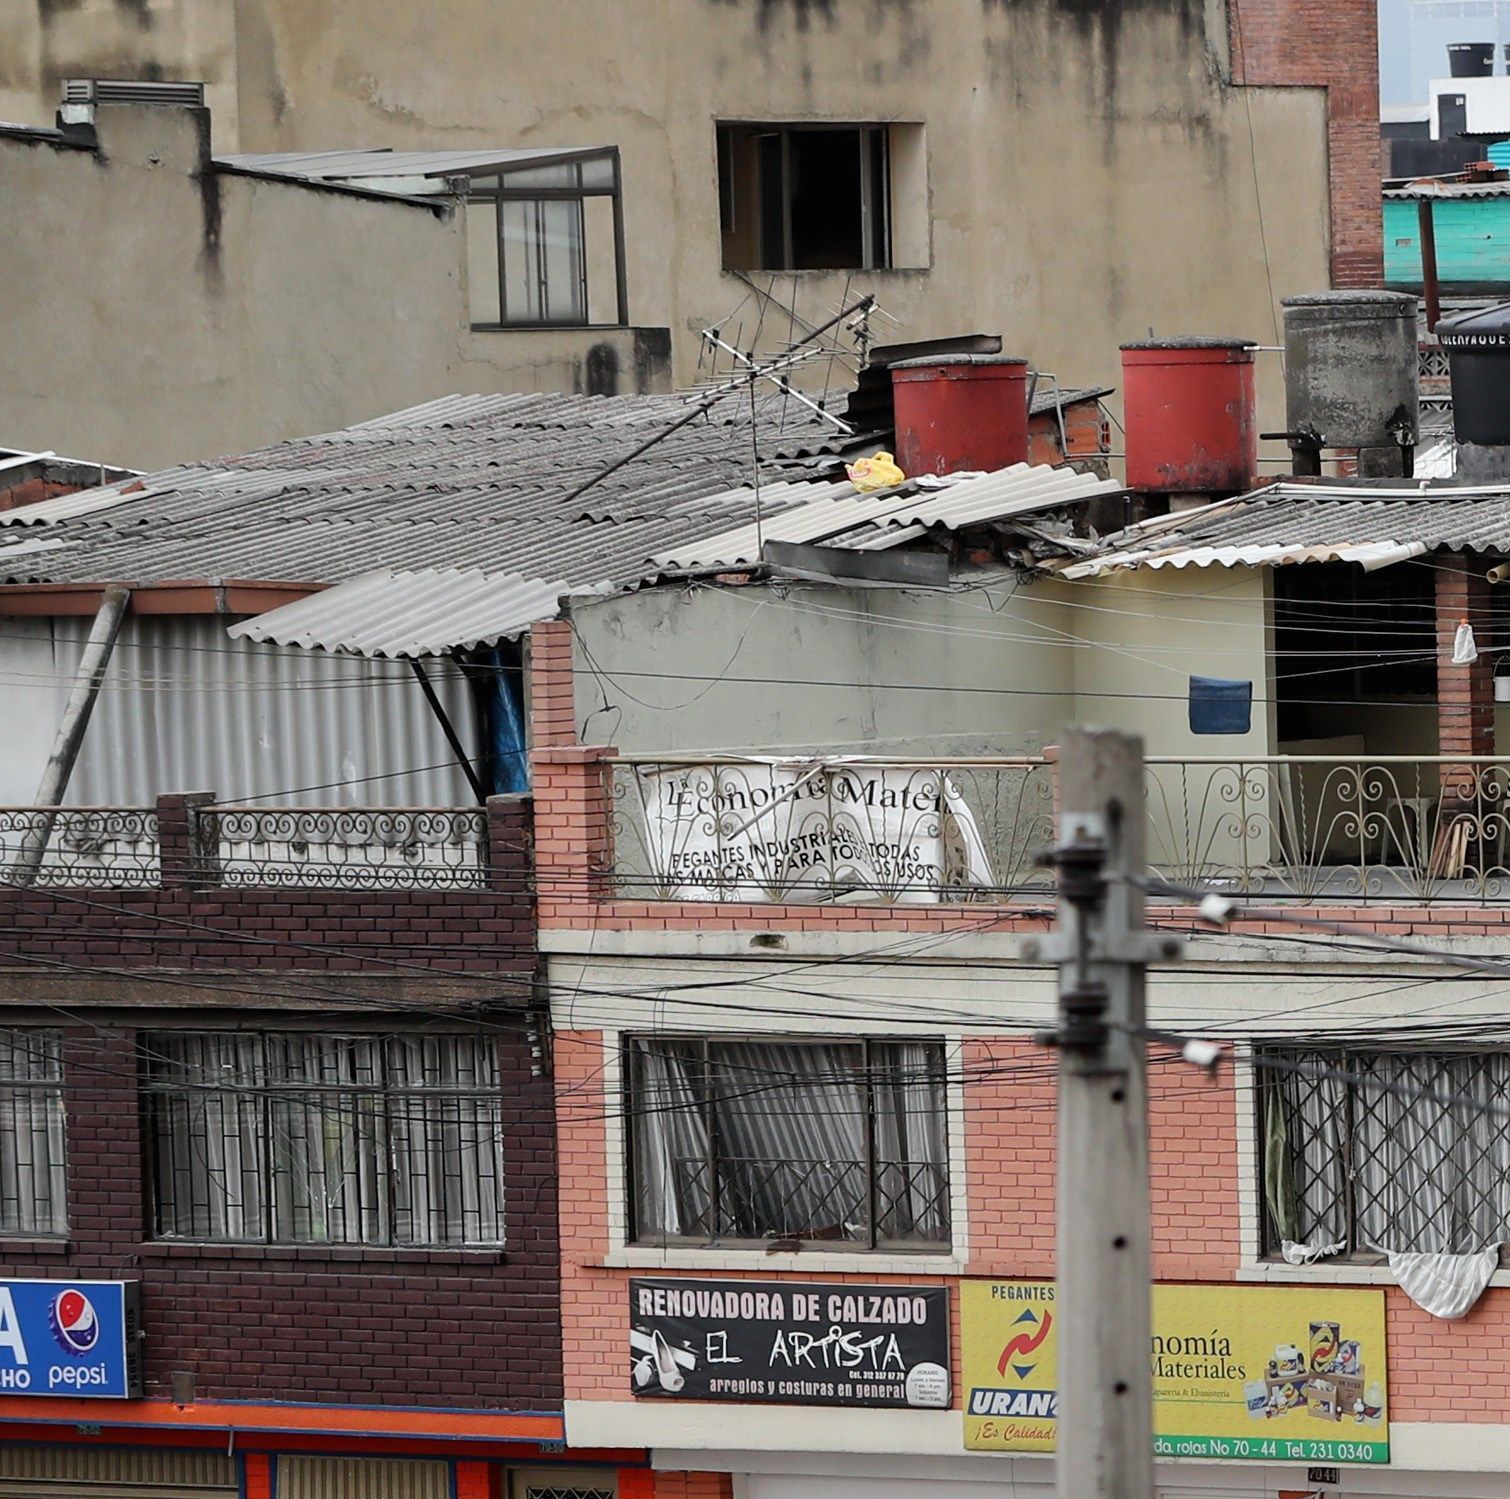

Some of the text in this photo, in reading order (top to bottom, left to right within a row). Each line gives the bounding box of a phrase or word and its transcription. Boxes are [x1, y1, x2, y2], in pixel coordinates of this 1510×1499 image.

[991, 1285, 1055, 1301] PEGANTES
[638, 1288, 928, 1325] RENOVADORA DE CALZADO
[705, 1330, 743, 1363] EL
[48, 1362, 106, 1389] pepsi
[709, 1378, 765, 1395] arreglos
[767, 1380, 776, 1397] y
[778, 1380, 834, 1397] costuras
[837, 1383, 853, 1398] en
[856, 1382, 905, 1401] general
[1176, 1441, 1207, 1458] rojas
[1210, 1440, 1230, 1455] No
[1233, 1441, 1250, 1456] 70
[1260, 1441, 1277, 1456] 44
[1309, 1442, 1335, 1459] 231
[1337, 1443, 1372, 1460] 0340
